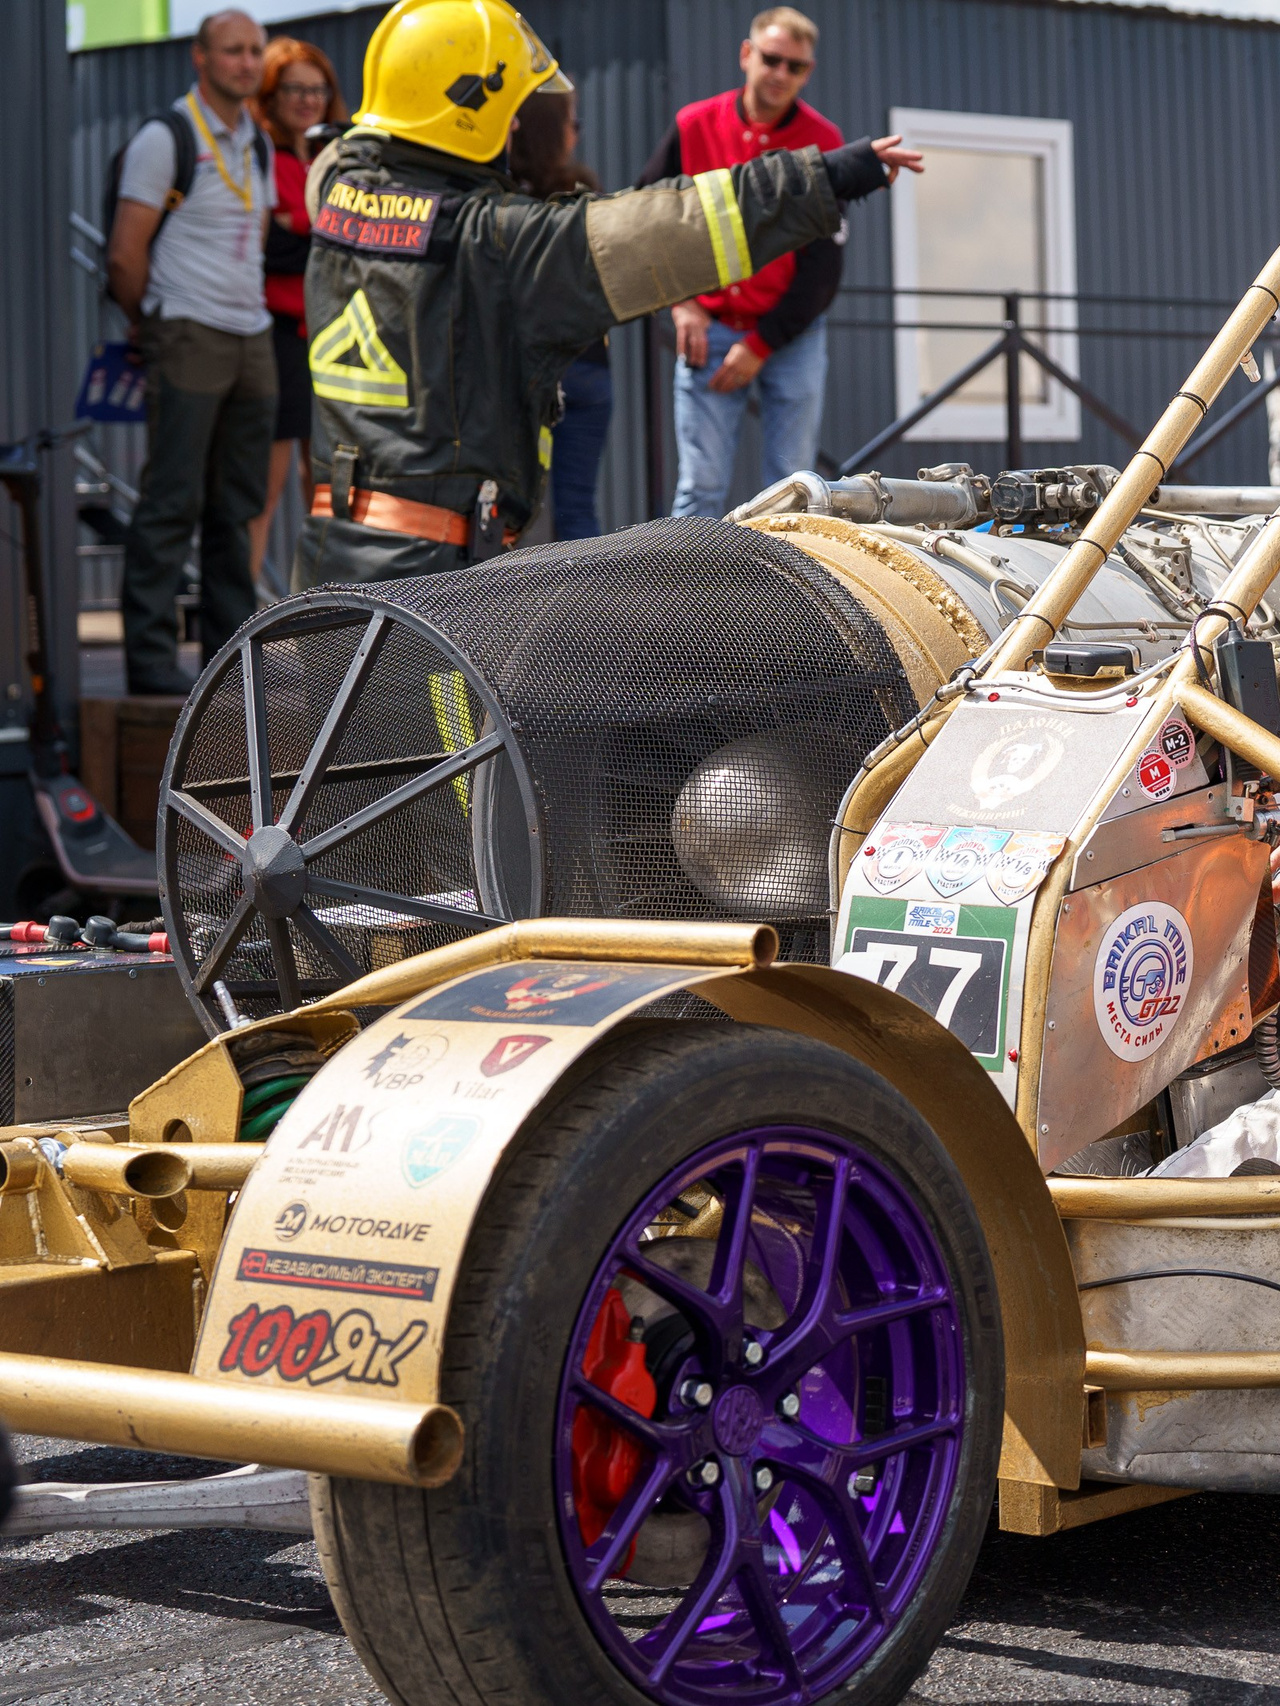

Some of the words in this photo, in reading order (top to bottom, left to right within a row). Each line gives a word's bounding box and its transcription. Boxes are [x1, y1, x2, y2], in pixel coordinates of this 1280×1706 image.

[1165, 734, 1187, 752] M-2
[1149, 765, 1161, 781] M
[932, 926, 954, 935] 2022
[1103, 915, 1158, 993] BAIKAL
[1163, 918, 1187, 985] MILE
[867, 942, 983, 1029] 77
[1106, 1001, 1131, 1045] МЕСТА
[1134, 1023, 1163, 1047] СИЛЫ
[372, 1072, 424, 1091] VBP
[310, 1214, 433, 1242] MOTORAVE
[264, 1257, 366, 1284] НЕЗАВИСИМЫЙ
